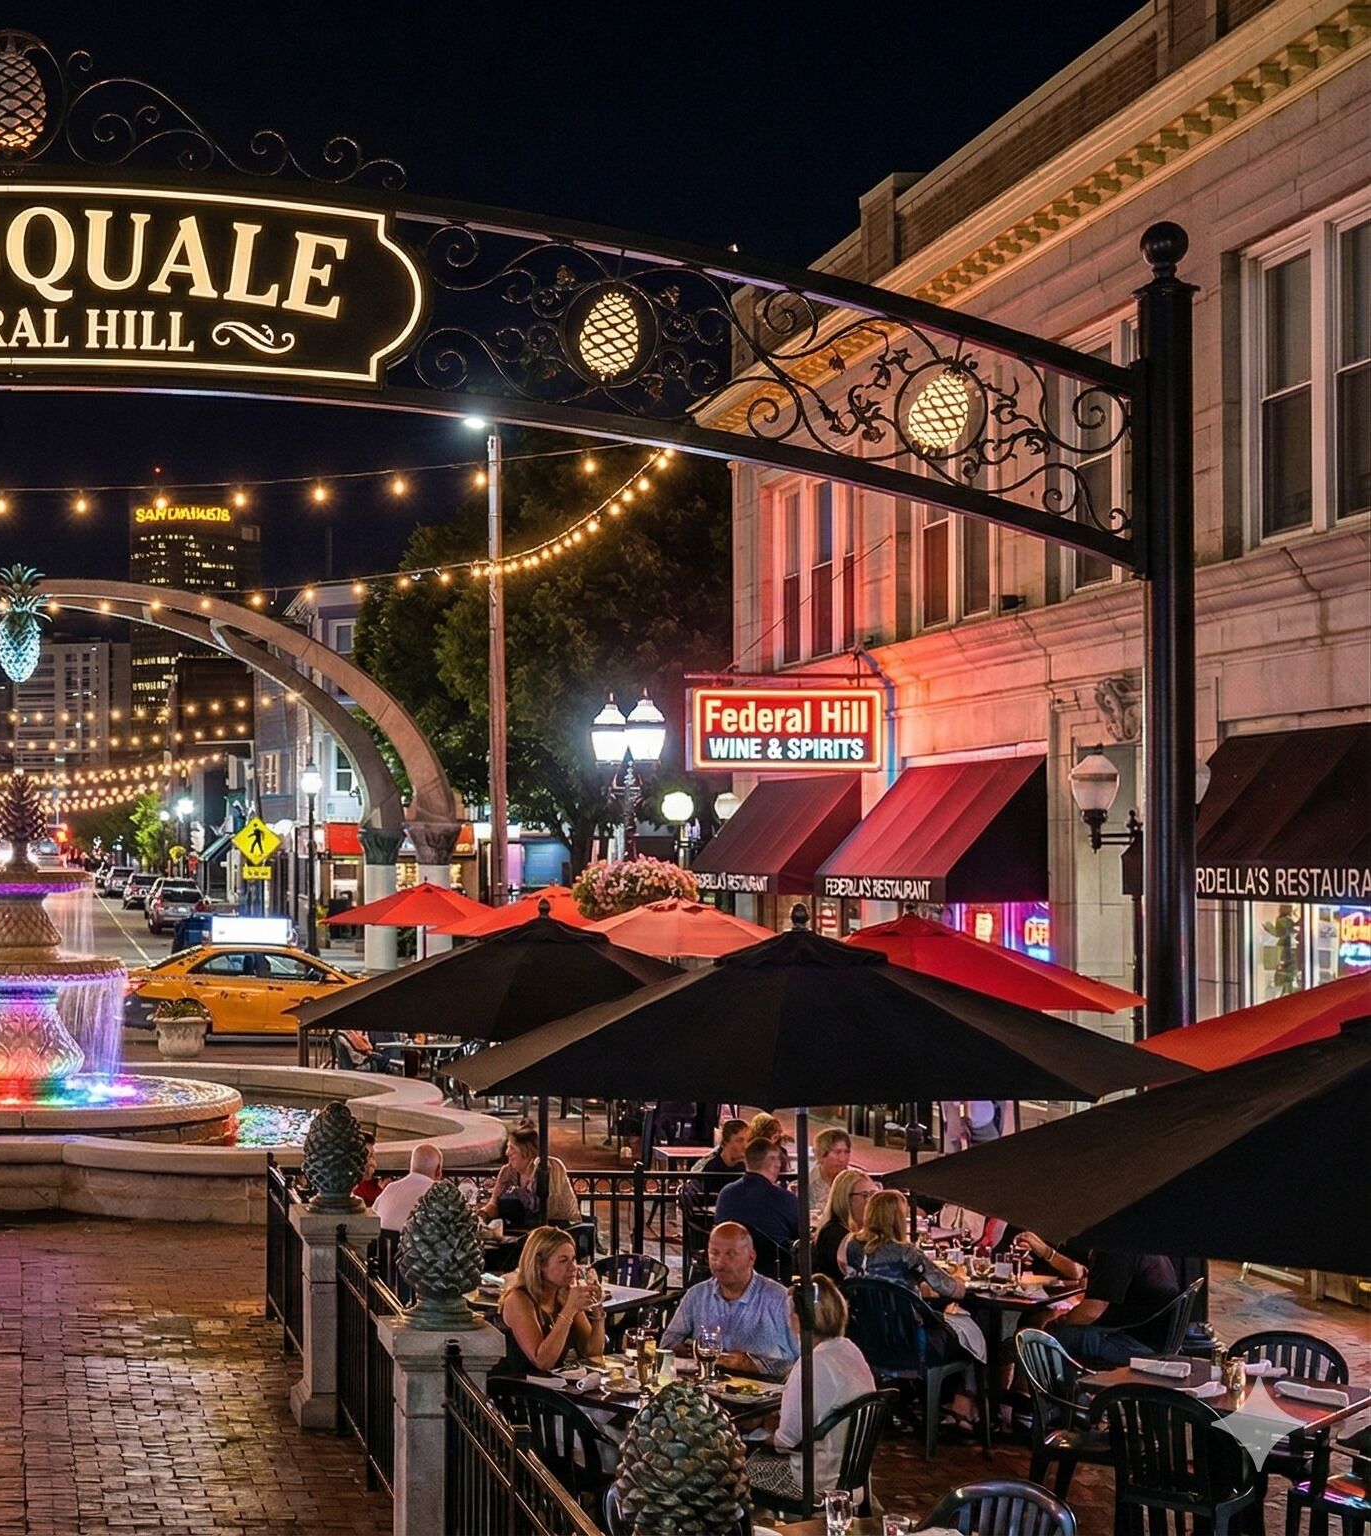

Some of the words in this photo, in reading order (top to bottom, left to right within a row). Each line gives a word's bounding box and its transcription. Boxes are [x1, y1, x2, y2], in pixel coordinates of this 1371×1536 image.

[85, 308, 195, 353] HILL
[705, 699, 812, 734] Federal
[820, 700, 869, 734] Hill
[708, 737, 762, 760] WINE
[767, 737, 783, 760] &
[787, 737, 865, 760] SPIRITS
[1195, 866, 1270, 896] RDELLA'S
[1274, 867, 1371, 898] RESTAURA
